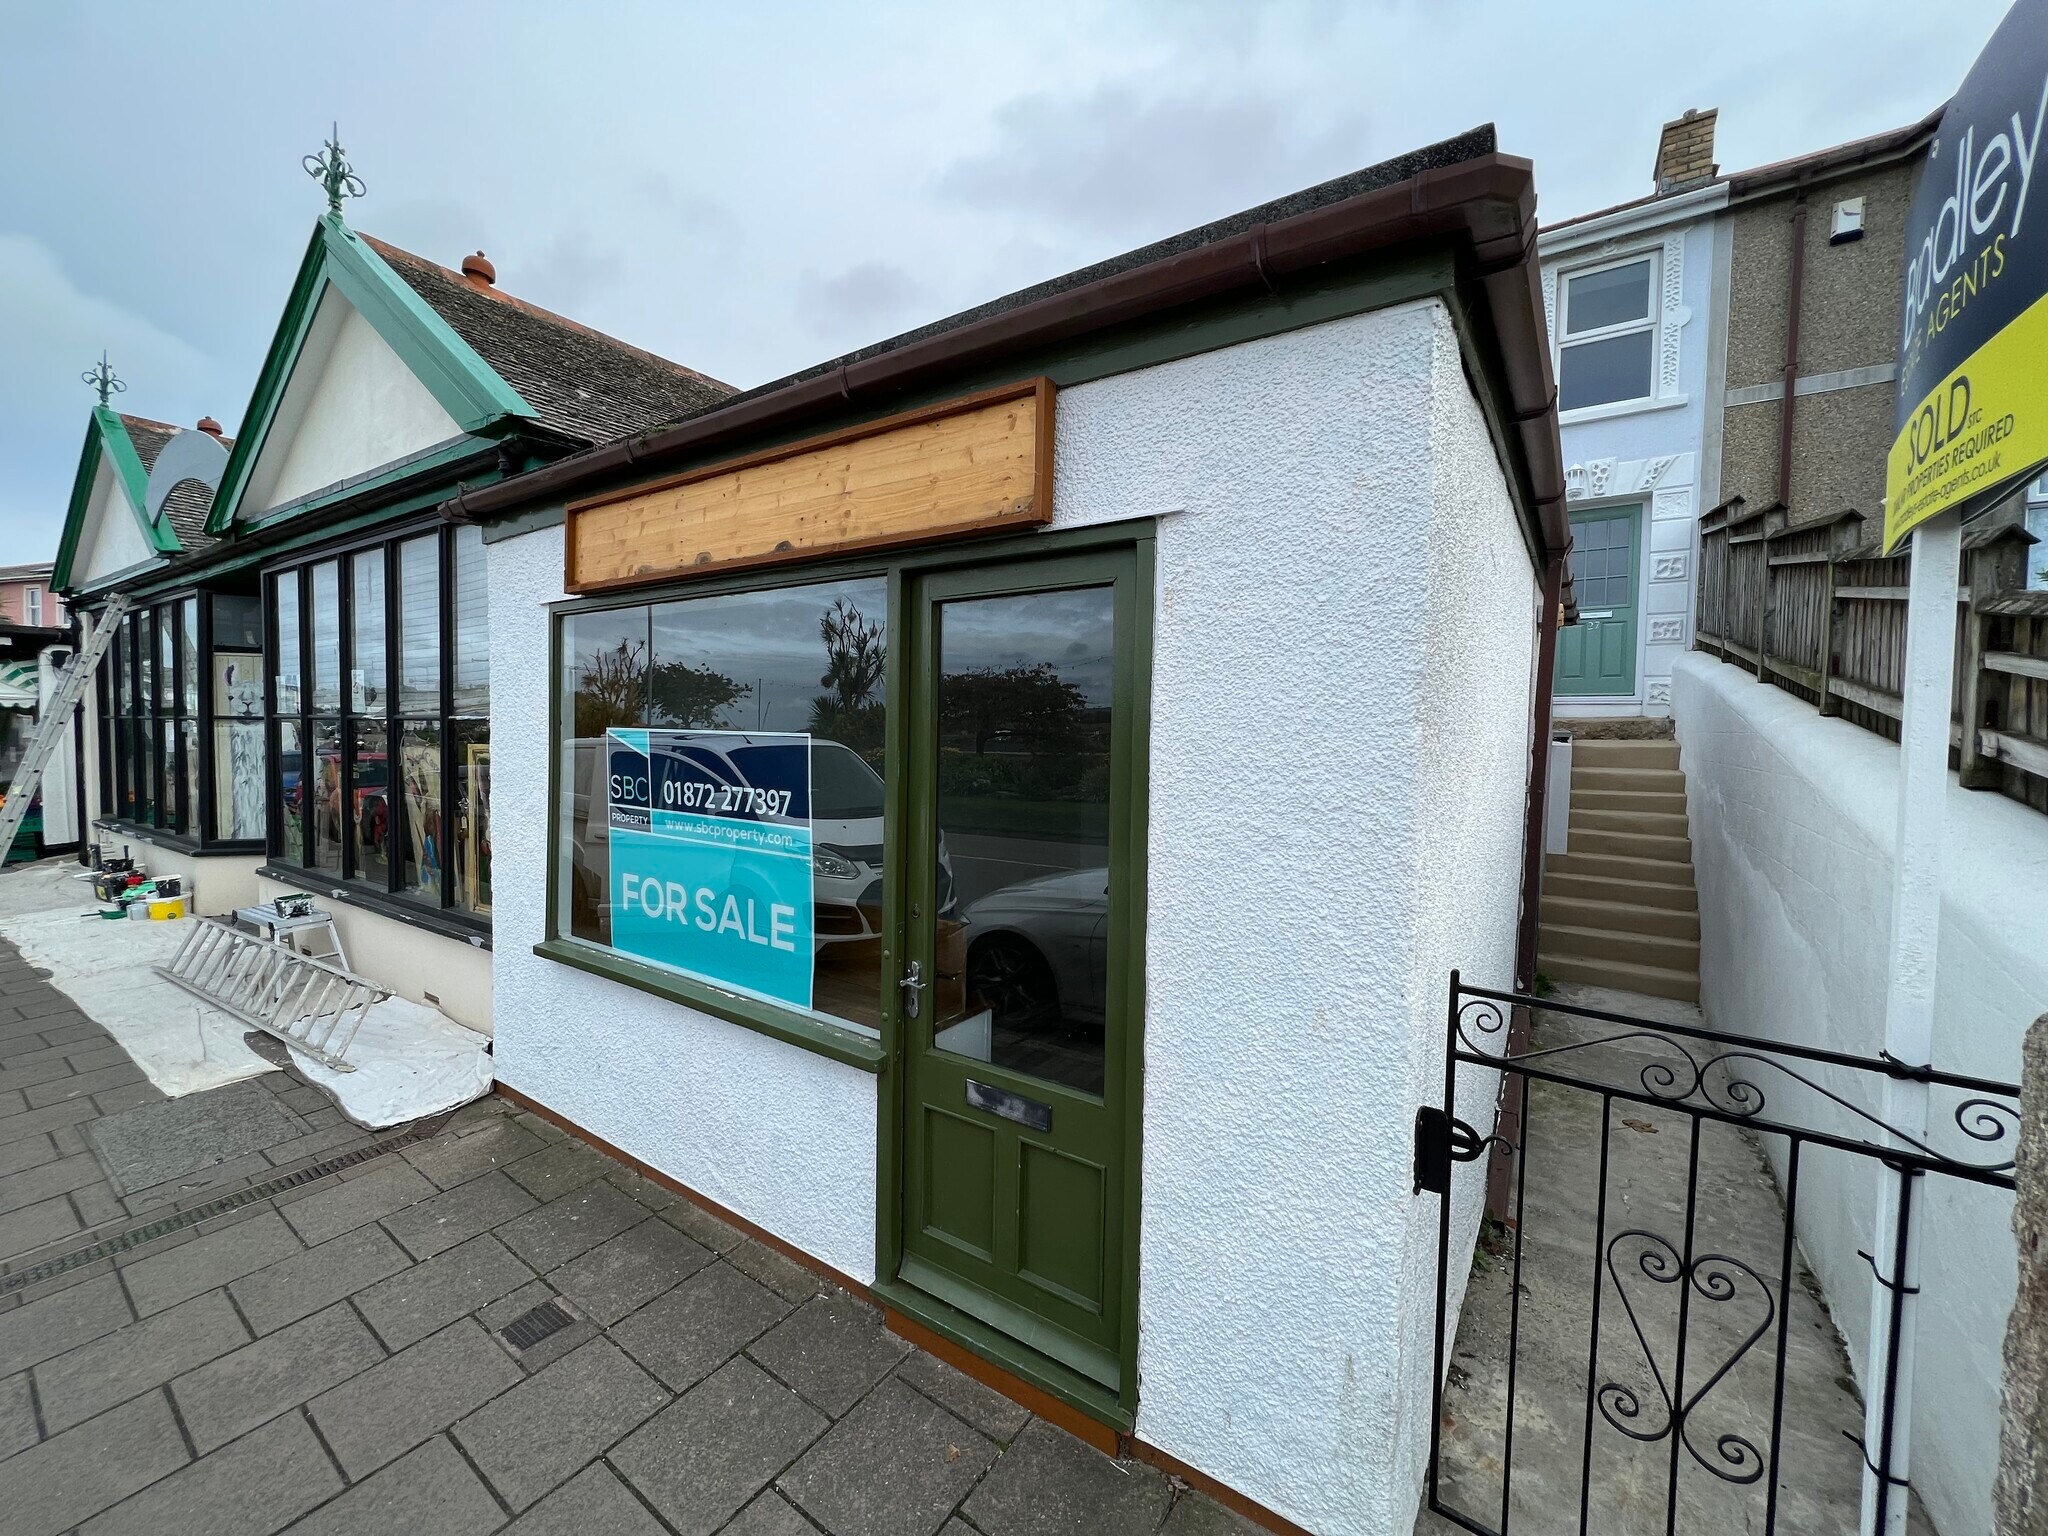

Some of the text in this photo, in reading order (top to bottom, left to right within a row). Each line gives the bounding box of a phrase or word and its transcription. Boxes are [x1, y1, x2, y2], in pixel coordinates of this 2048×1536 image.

[1926, 233, 2005, 348] AGENTS
[1907, 375, 1971, 476] SOLD
[1951, 413, 2014, 469] REQUIRED
[1587, 620, 1600, 631] 27
[611, 774, 648, 802] SBC
[663, 780, 792, 817] 01872 277397
[611, 812, 648, 825] PROPERTY
[664, 818, 793, 847] www.sbcproperty.com
[622, 872, 795, 952] FOR SALE
